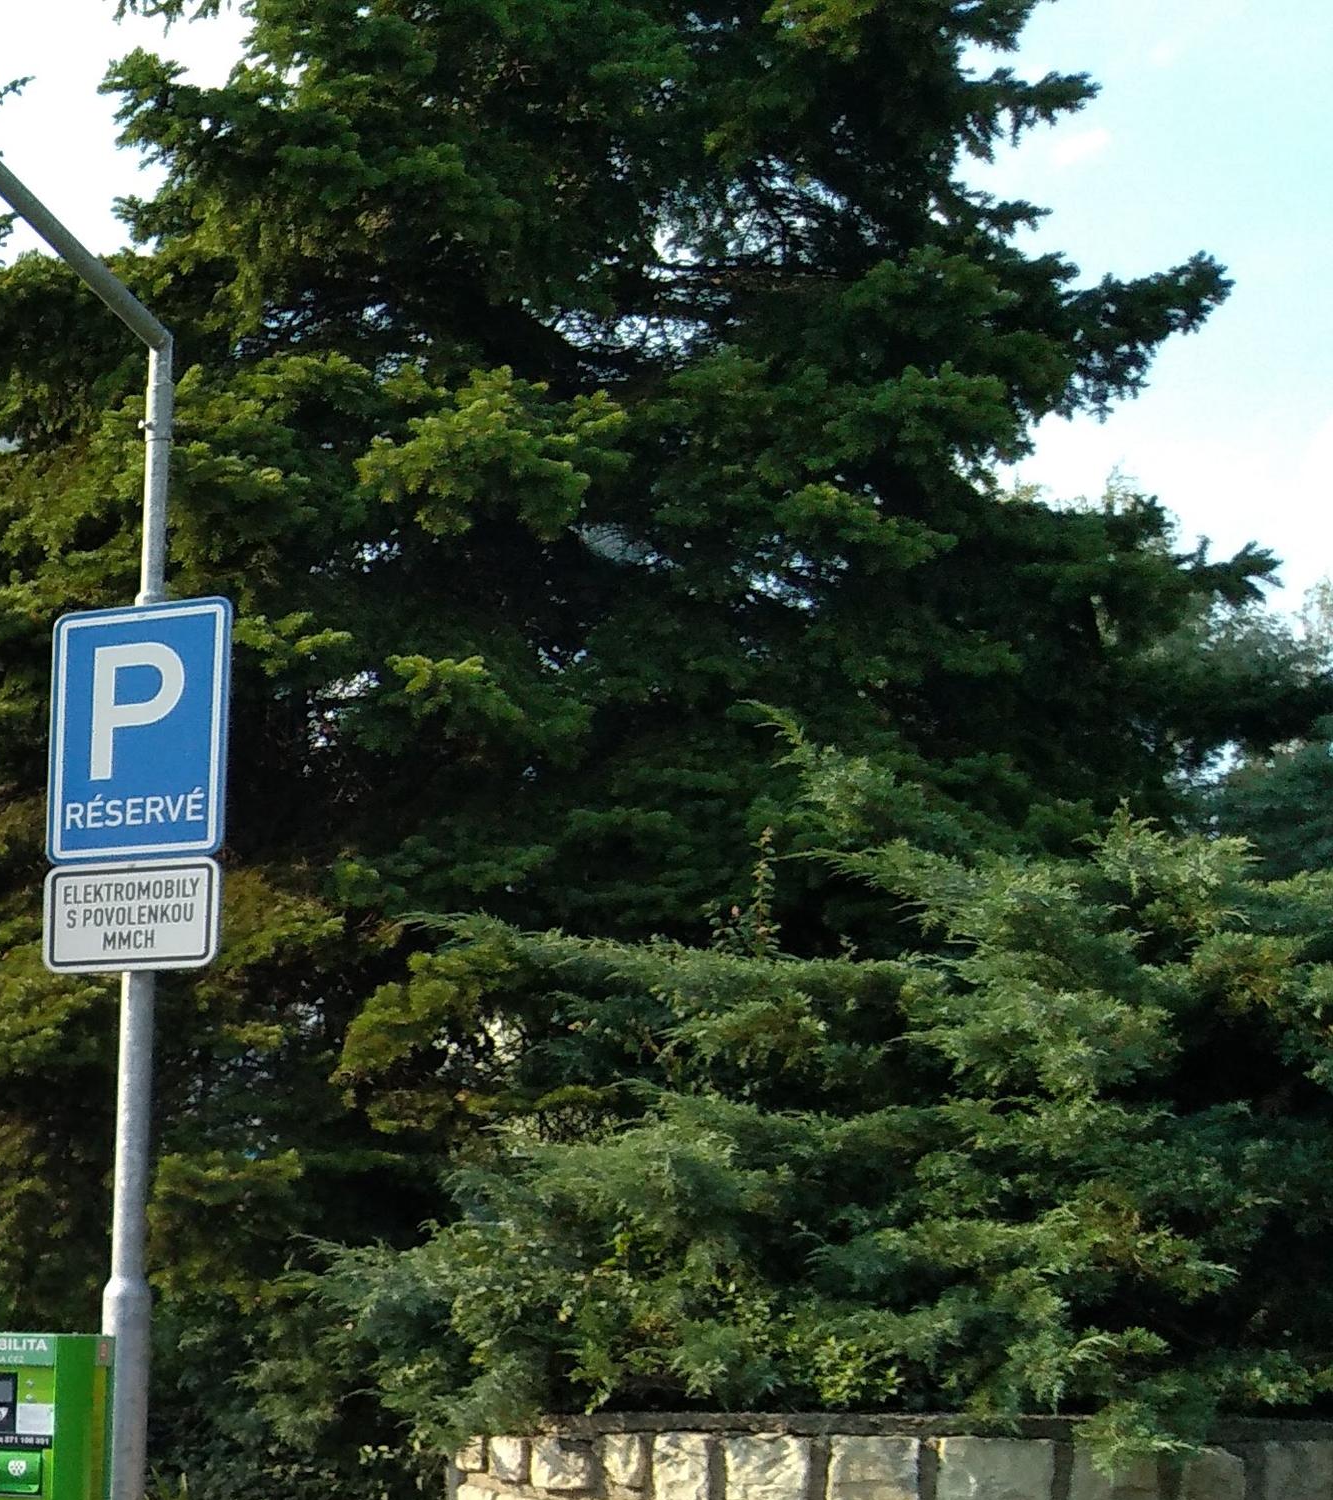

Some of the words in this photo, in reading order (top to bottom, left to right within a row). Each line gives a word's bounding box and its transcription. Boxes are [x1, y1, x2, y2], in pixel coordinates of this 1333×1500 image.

[89, 641, 185, 781] P
[65, 786, 205, 831] RÉSERVÉ
[62, 877, 200, 906] ELEKTROMOBILY
[66, 909, 77, 929] S
[82, 902, 195, 928] POVOLENKOU
[102, 929, 156, 952] MMCH
